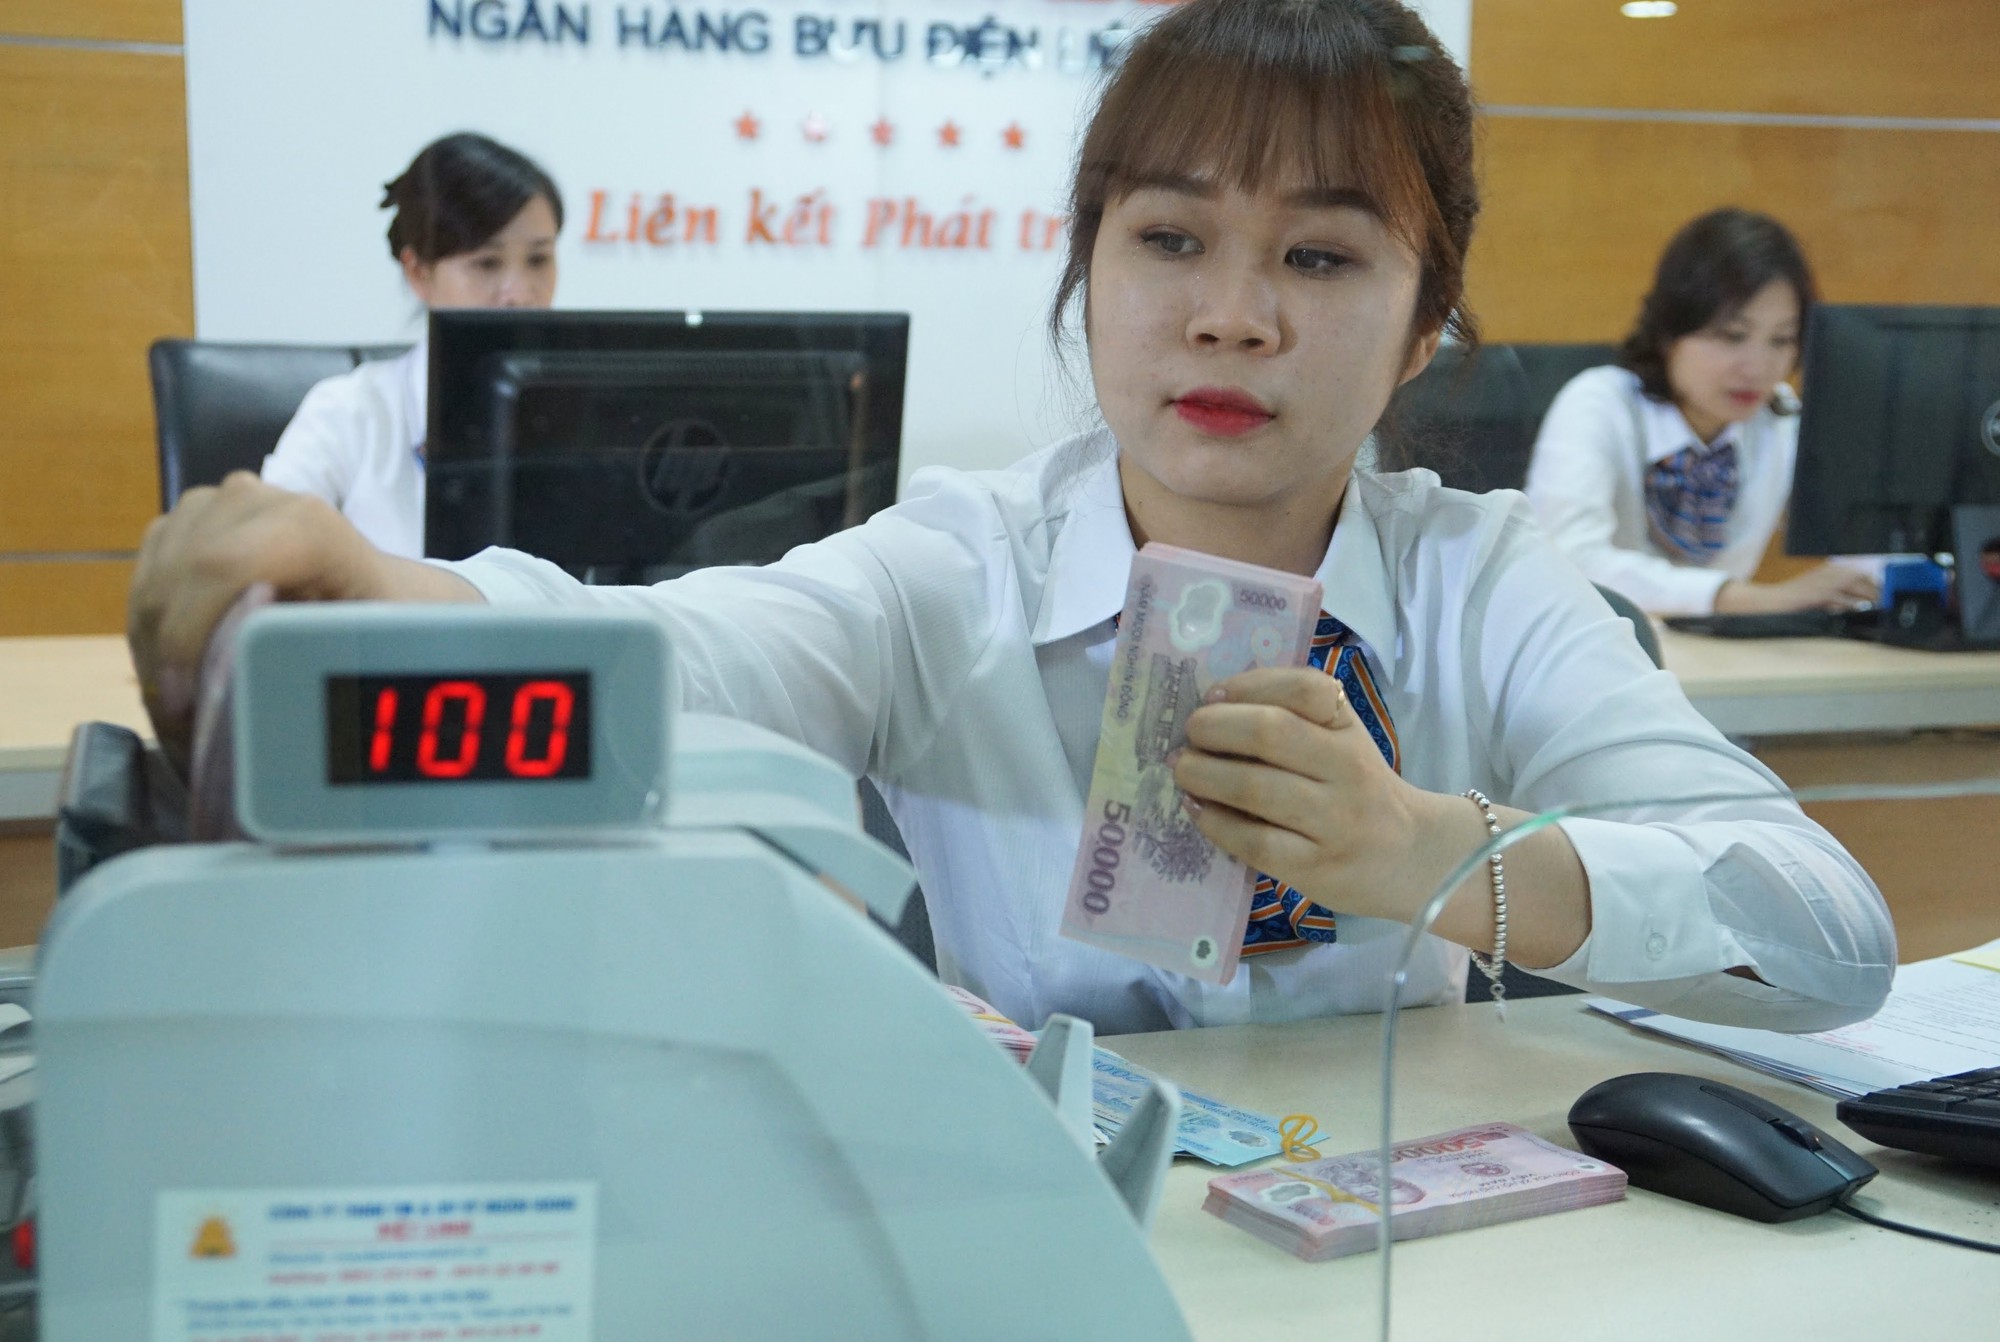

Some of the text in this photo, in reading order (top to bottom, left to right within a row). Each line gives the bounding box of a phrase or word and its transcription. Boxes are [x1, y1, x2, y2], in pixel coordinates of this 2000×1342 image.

[584, 188, 720, 247] Liên
[746, 187, 836, 247] kết
[860, 195, 997, 251] Phát
[1239, 588, 1288, 611] 50000
[369, 680, 575, 779] 100
[1082, 799, 1132, 915] 50000
